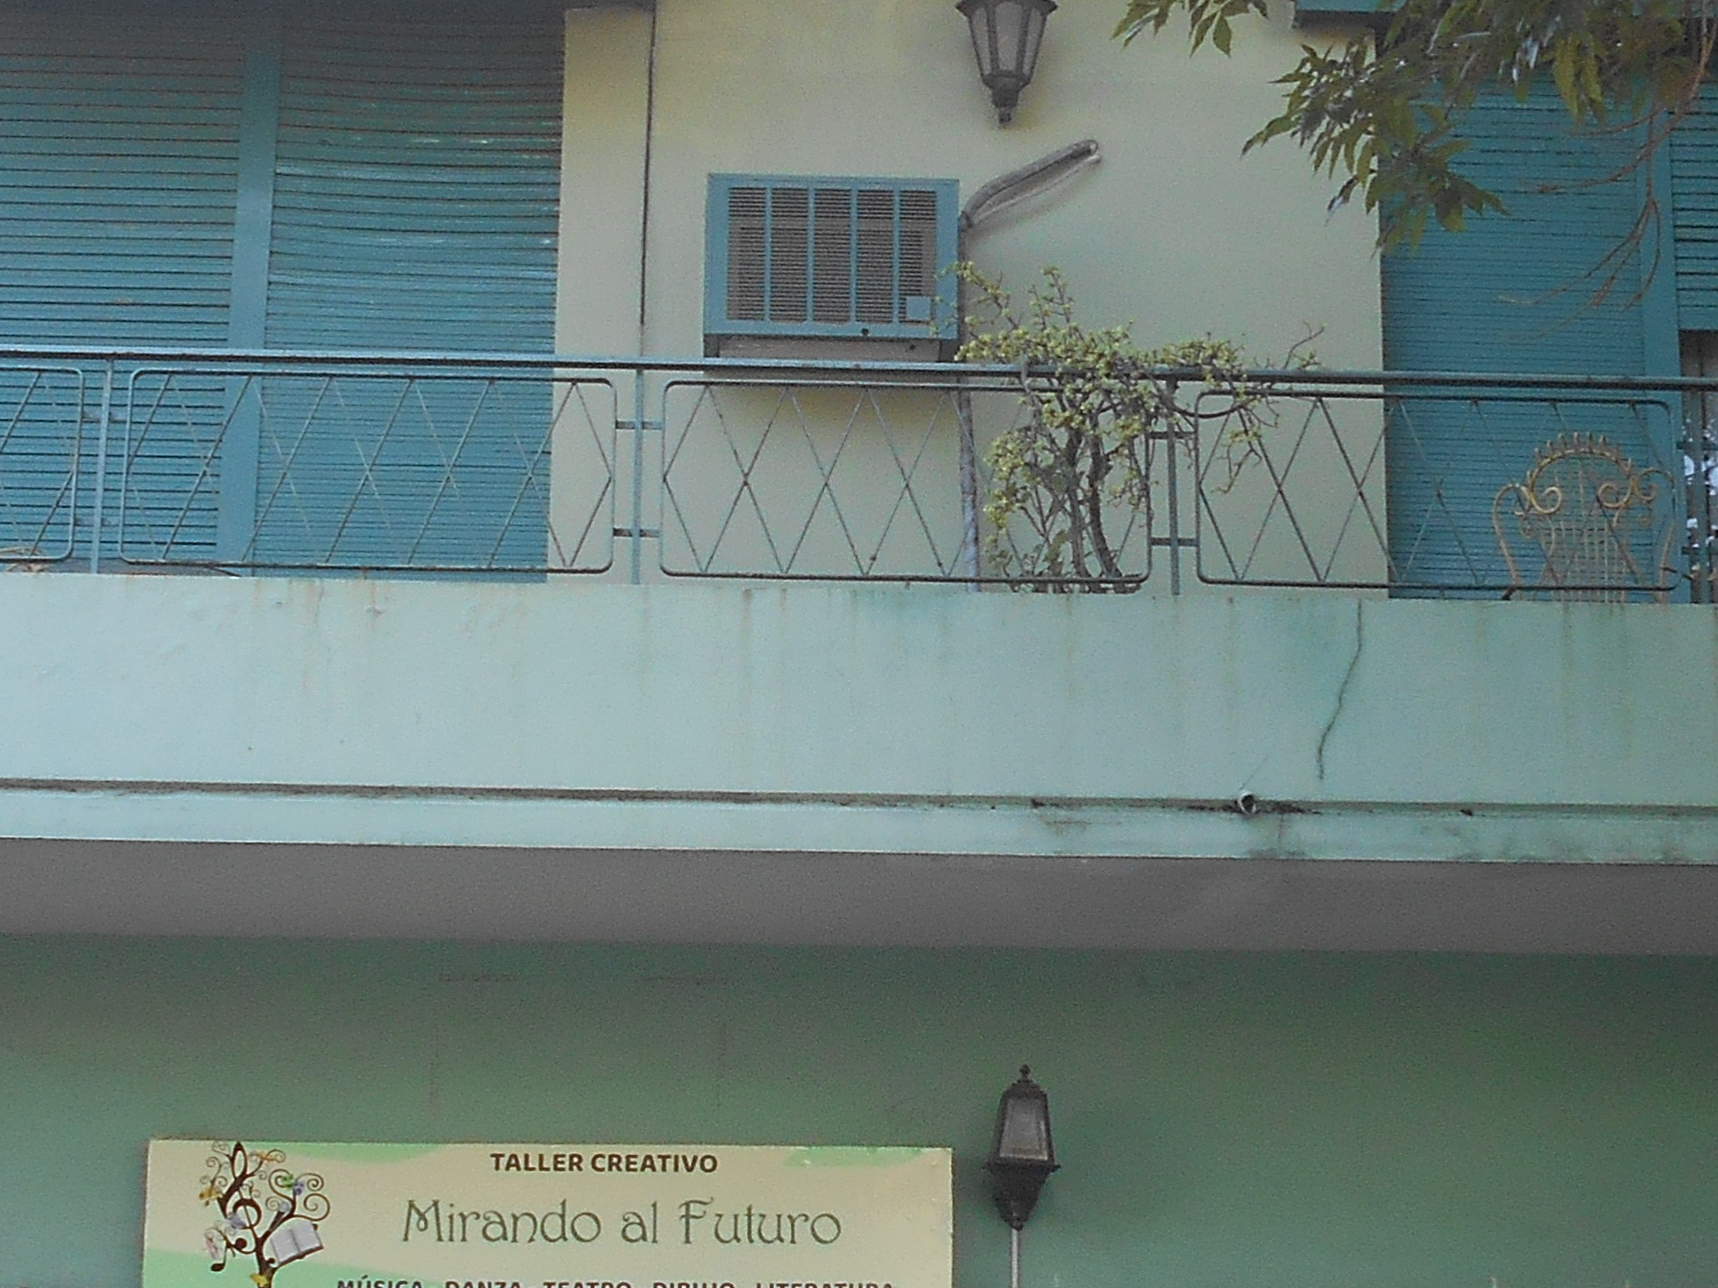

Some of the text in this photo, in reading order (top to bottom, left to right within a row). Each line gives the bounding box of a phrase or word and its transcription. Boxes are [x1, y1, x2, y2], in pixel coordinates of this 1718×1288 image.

[489, 1152, 718, 1173] TALLER CREATIVO
[402, 1196, 842, 1244] Mirando al Futuro
